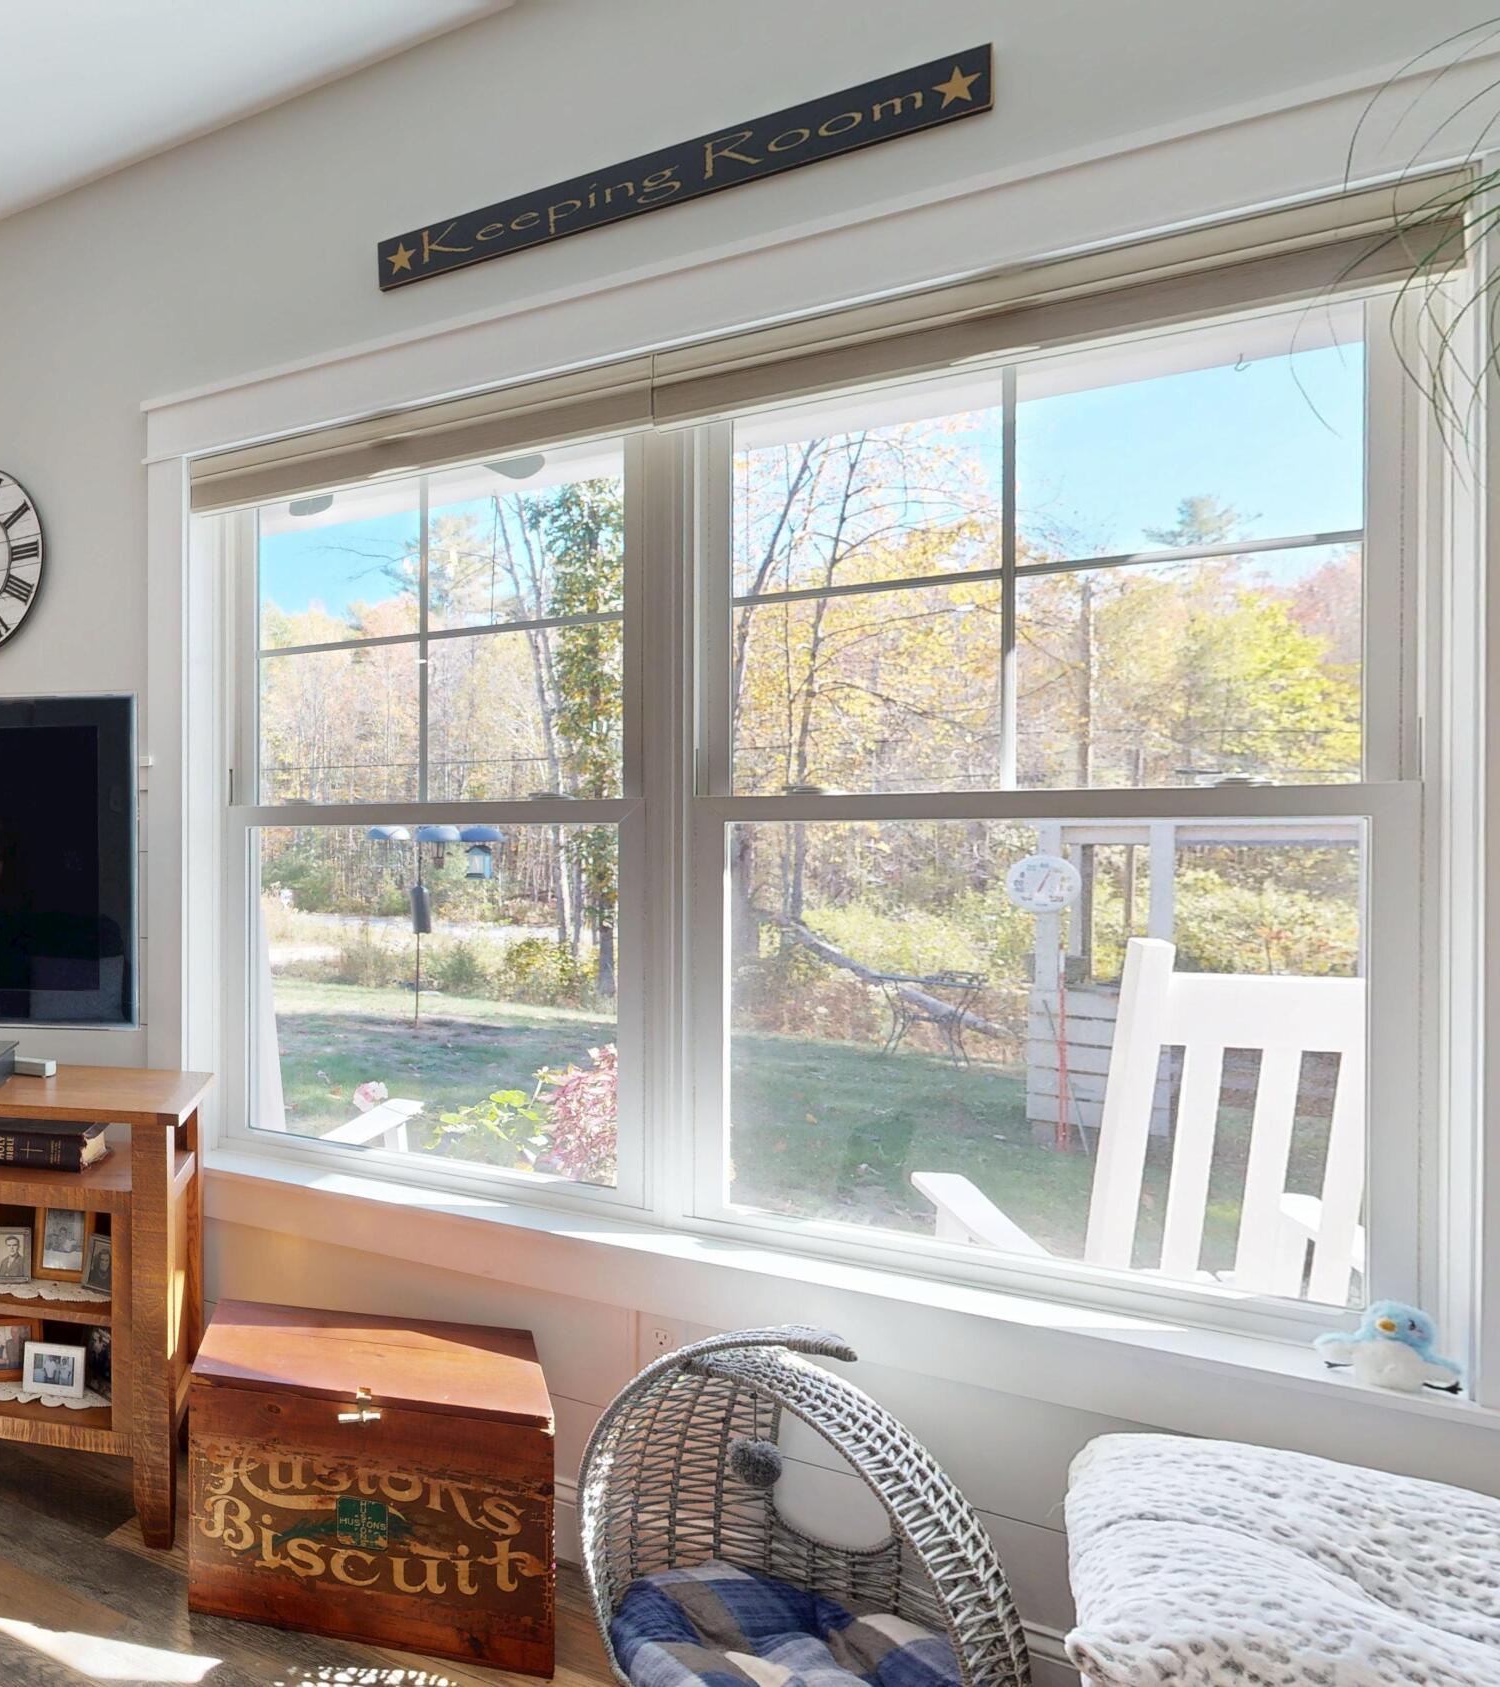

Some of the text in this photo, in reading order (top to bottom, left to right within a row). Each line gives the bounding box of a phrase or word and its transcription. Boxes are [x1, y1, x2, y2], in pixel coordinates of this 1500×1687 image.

[421, 89, 924, 263] Keeping Room
[3, 499, 31, 530] II
[11, 539, 40, 562] III
[5, 1135, 15, 1161] BIBLE
[201, 1494, 544, 1595] Biscuit
